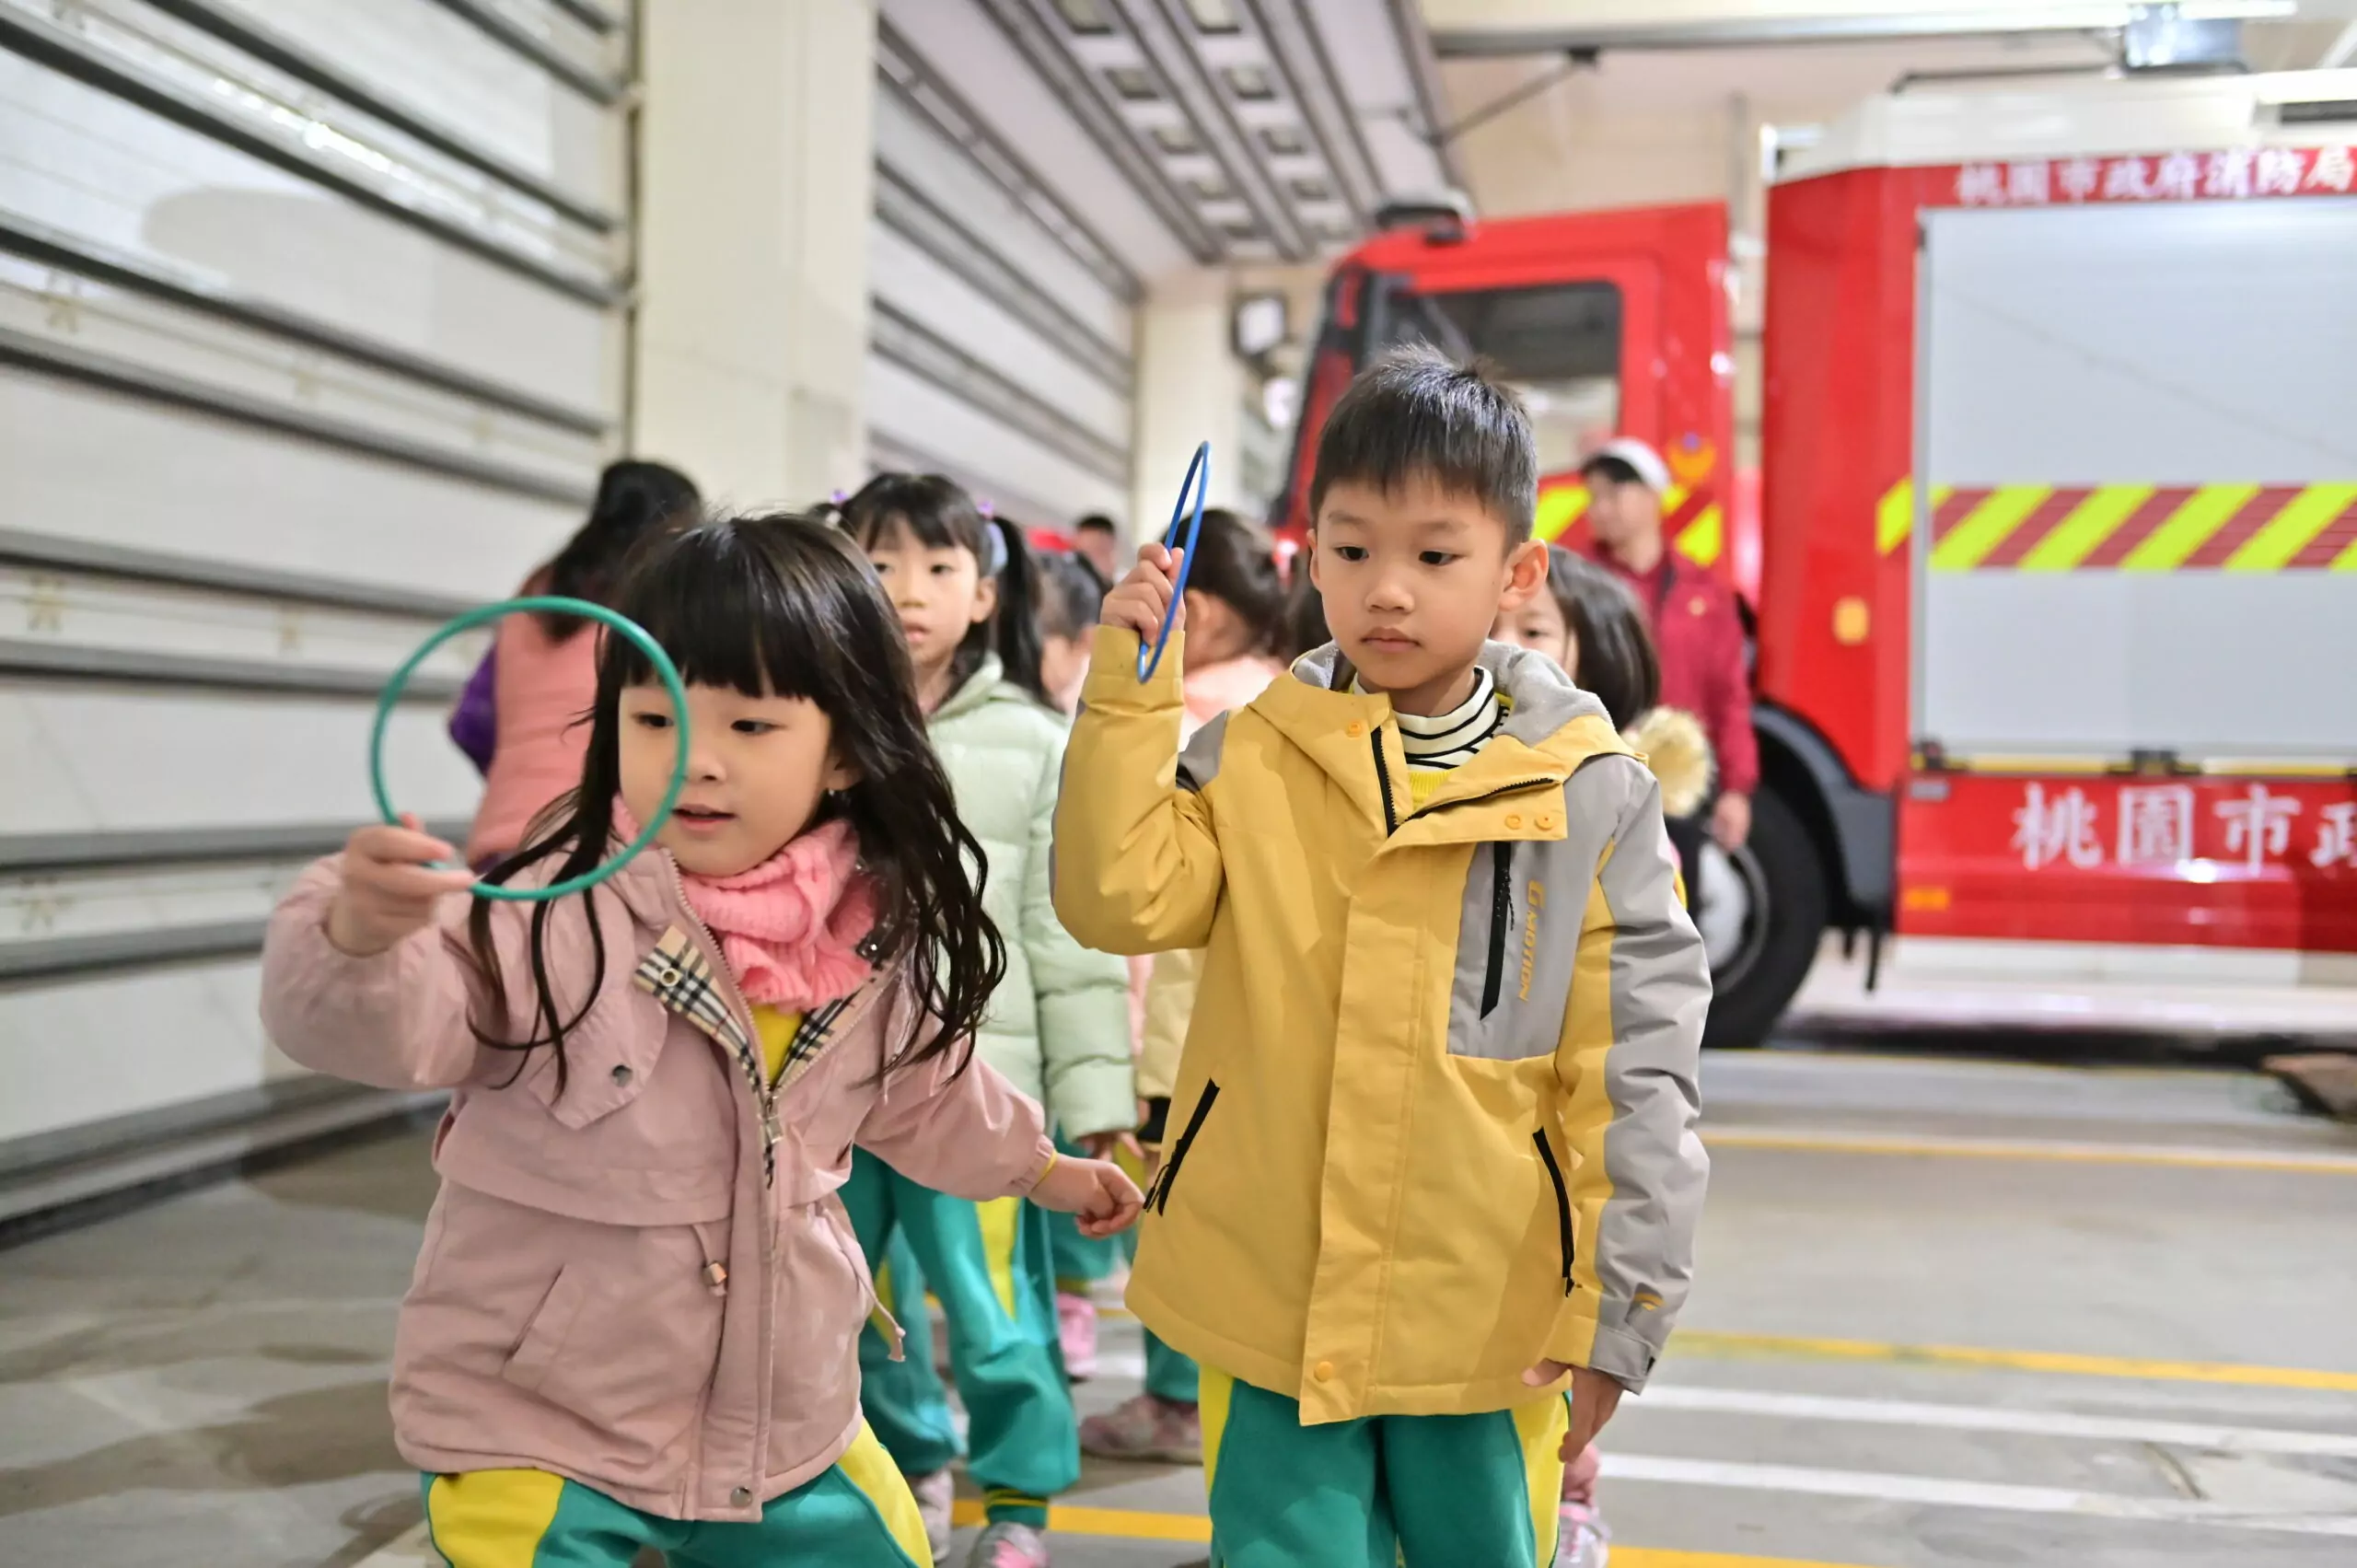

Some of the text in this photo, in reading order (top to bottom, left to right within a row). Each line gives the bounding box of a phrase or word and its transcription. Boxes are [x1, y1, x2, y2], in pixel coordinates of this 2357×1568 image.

[1956, 145, 2355, 205] 桃園市政府消防局
